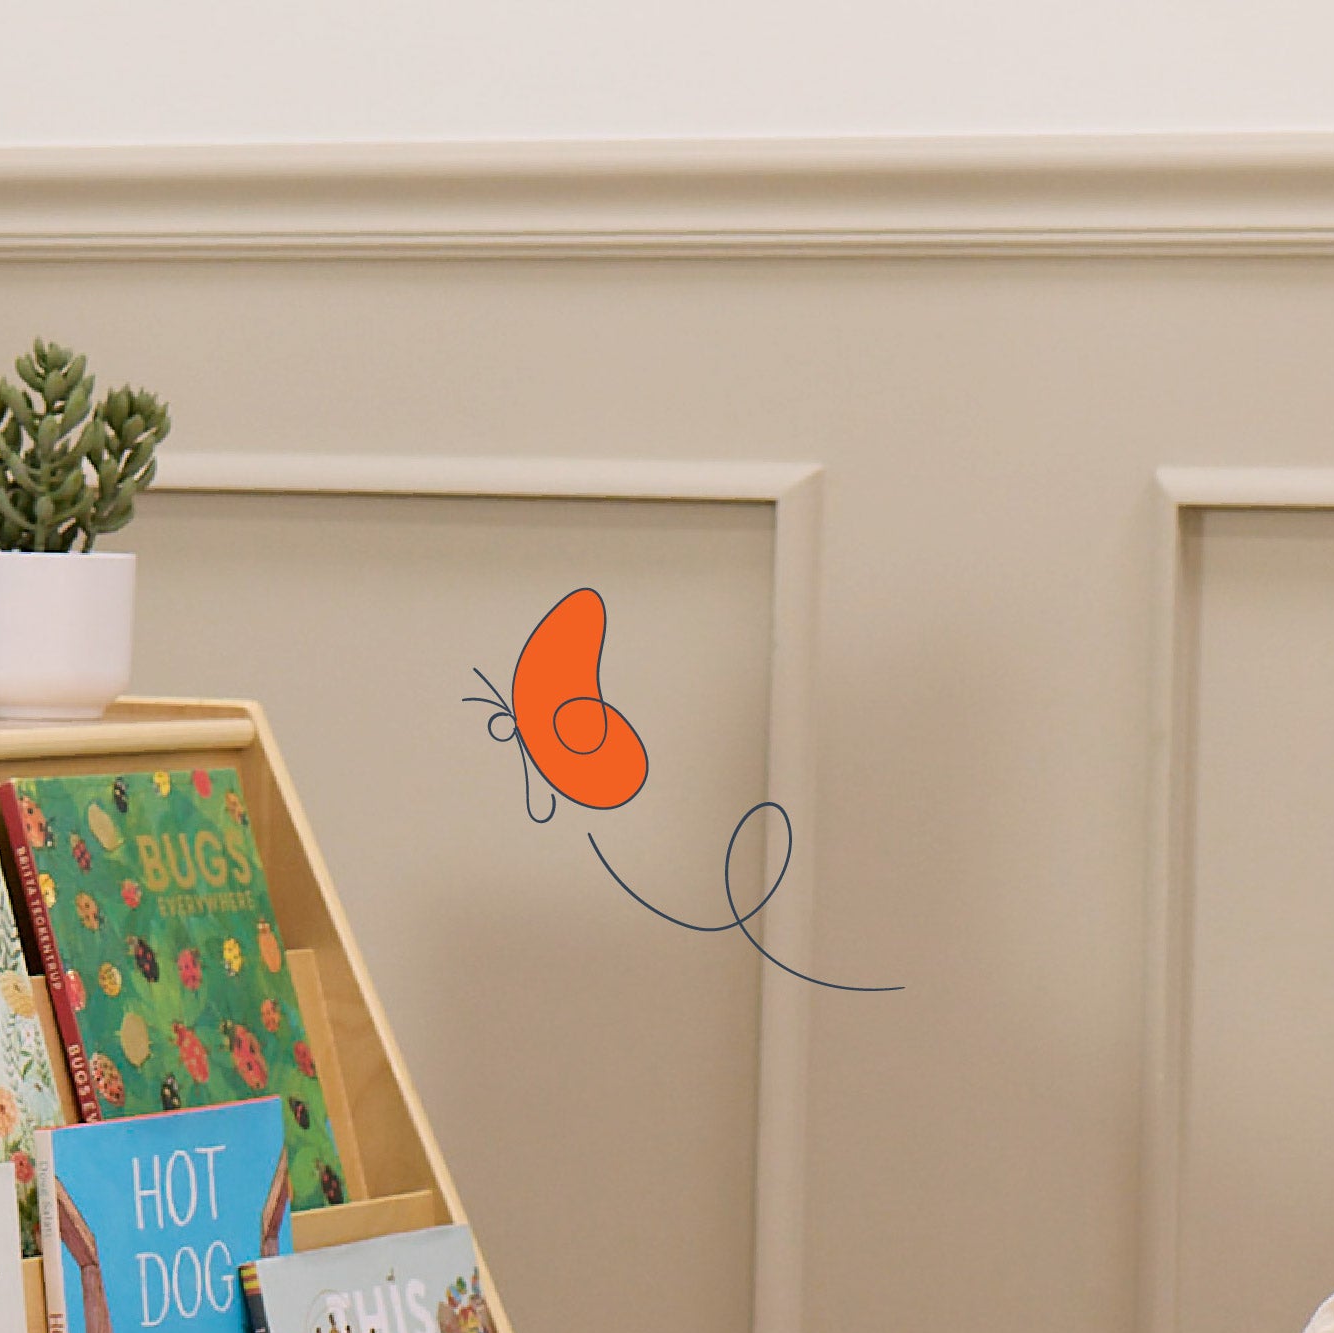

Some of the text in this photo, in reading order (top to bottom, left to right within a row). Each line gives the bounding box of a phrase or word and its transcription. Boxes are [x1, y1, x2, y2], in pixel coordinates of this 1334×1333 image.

[136, 829, 253, 893] BUGS
[157, 890, 256, 917] EVERYWHERE
[17, 846, 38, 899] BRITTA
[67, 1044, 92, 1099] BUGS
[132, 1145, 226, 1230] HOT
[136, 1240, 234, 1328] DOG
